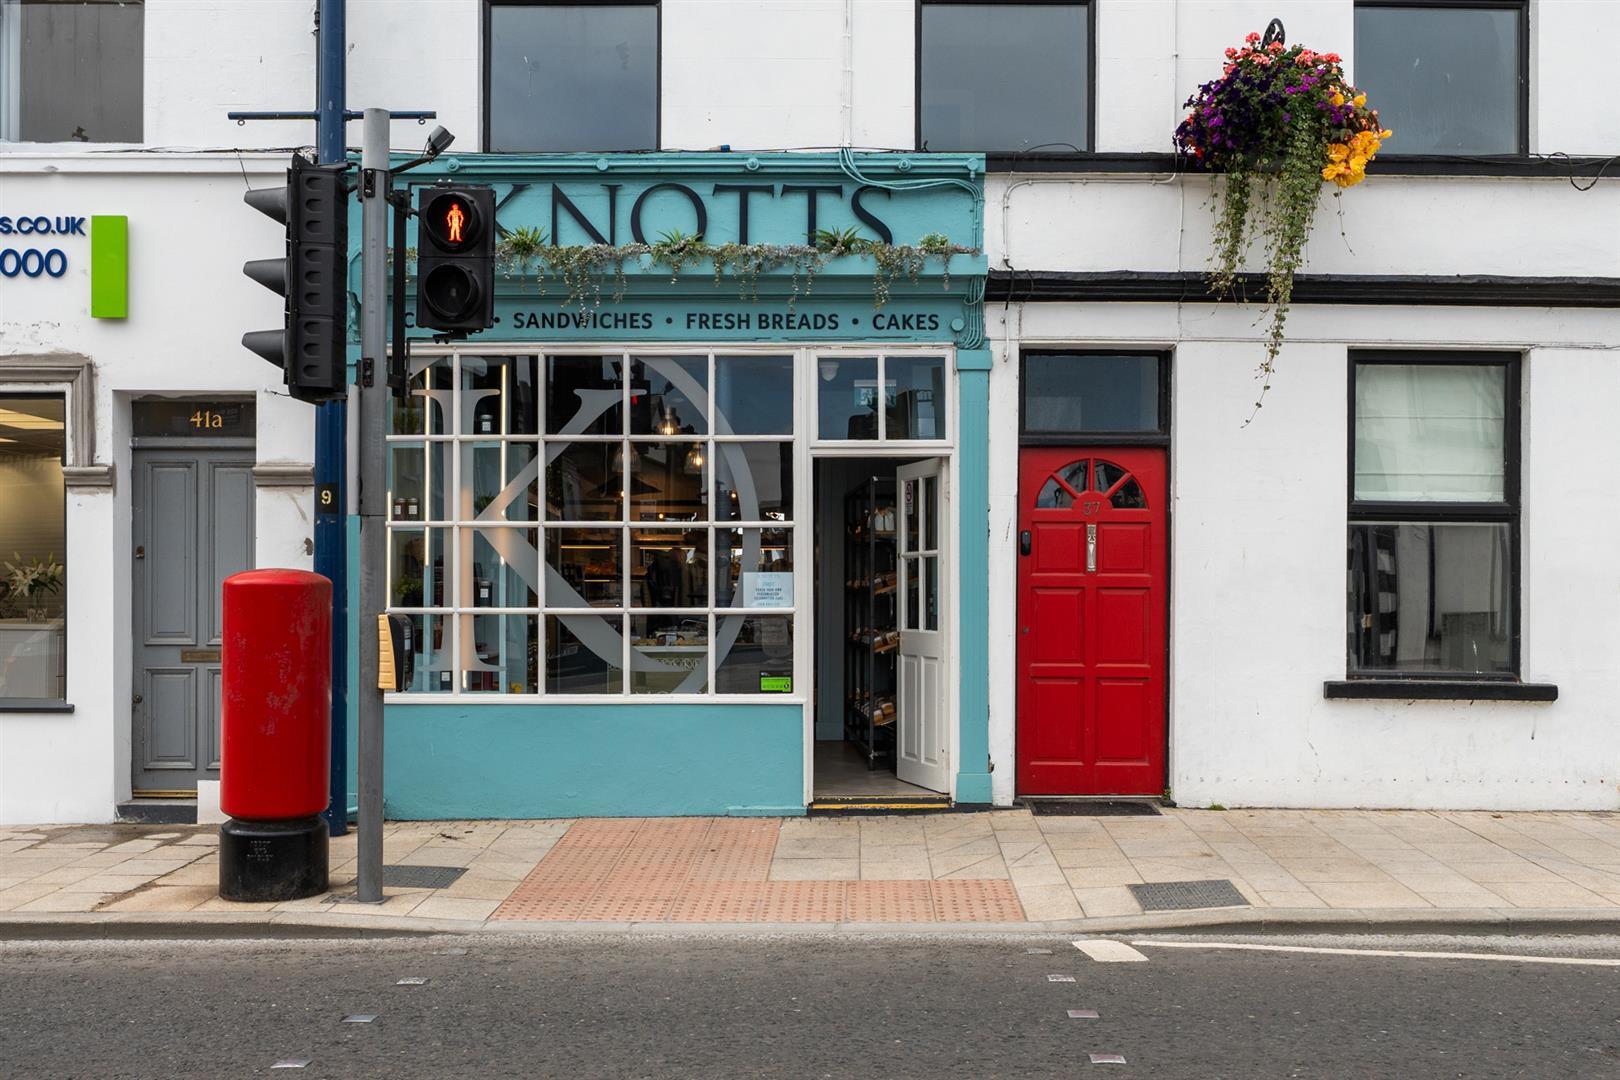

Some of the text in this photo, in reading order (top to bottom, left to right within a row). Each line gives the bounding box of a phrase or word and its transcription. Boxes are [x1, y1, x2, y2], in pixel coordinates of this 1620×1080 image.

[513, 312, 939, 330] SANDWICHES FRESH BREADS CAKES
[190, 410, 223, 429] 41a
[321, 490, 332, 505] 9
[1083, 501, 1101, 515] 37
